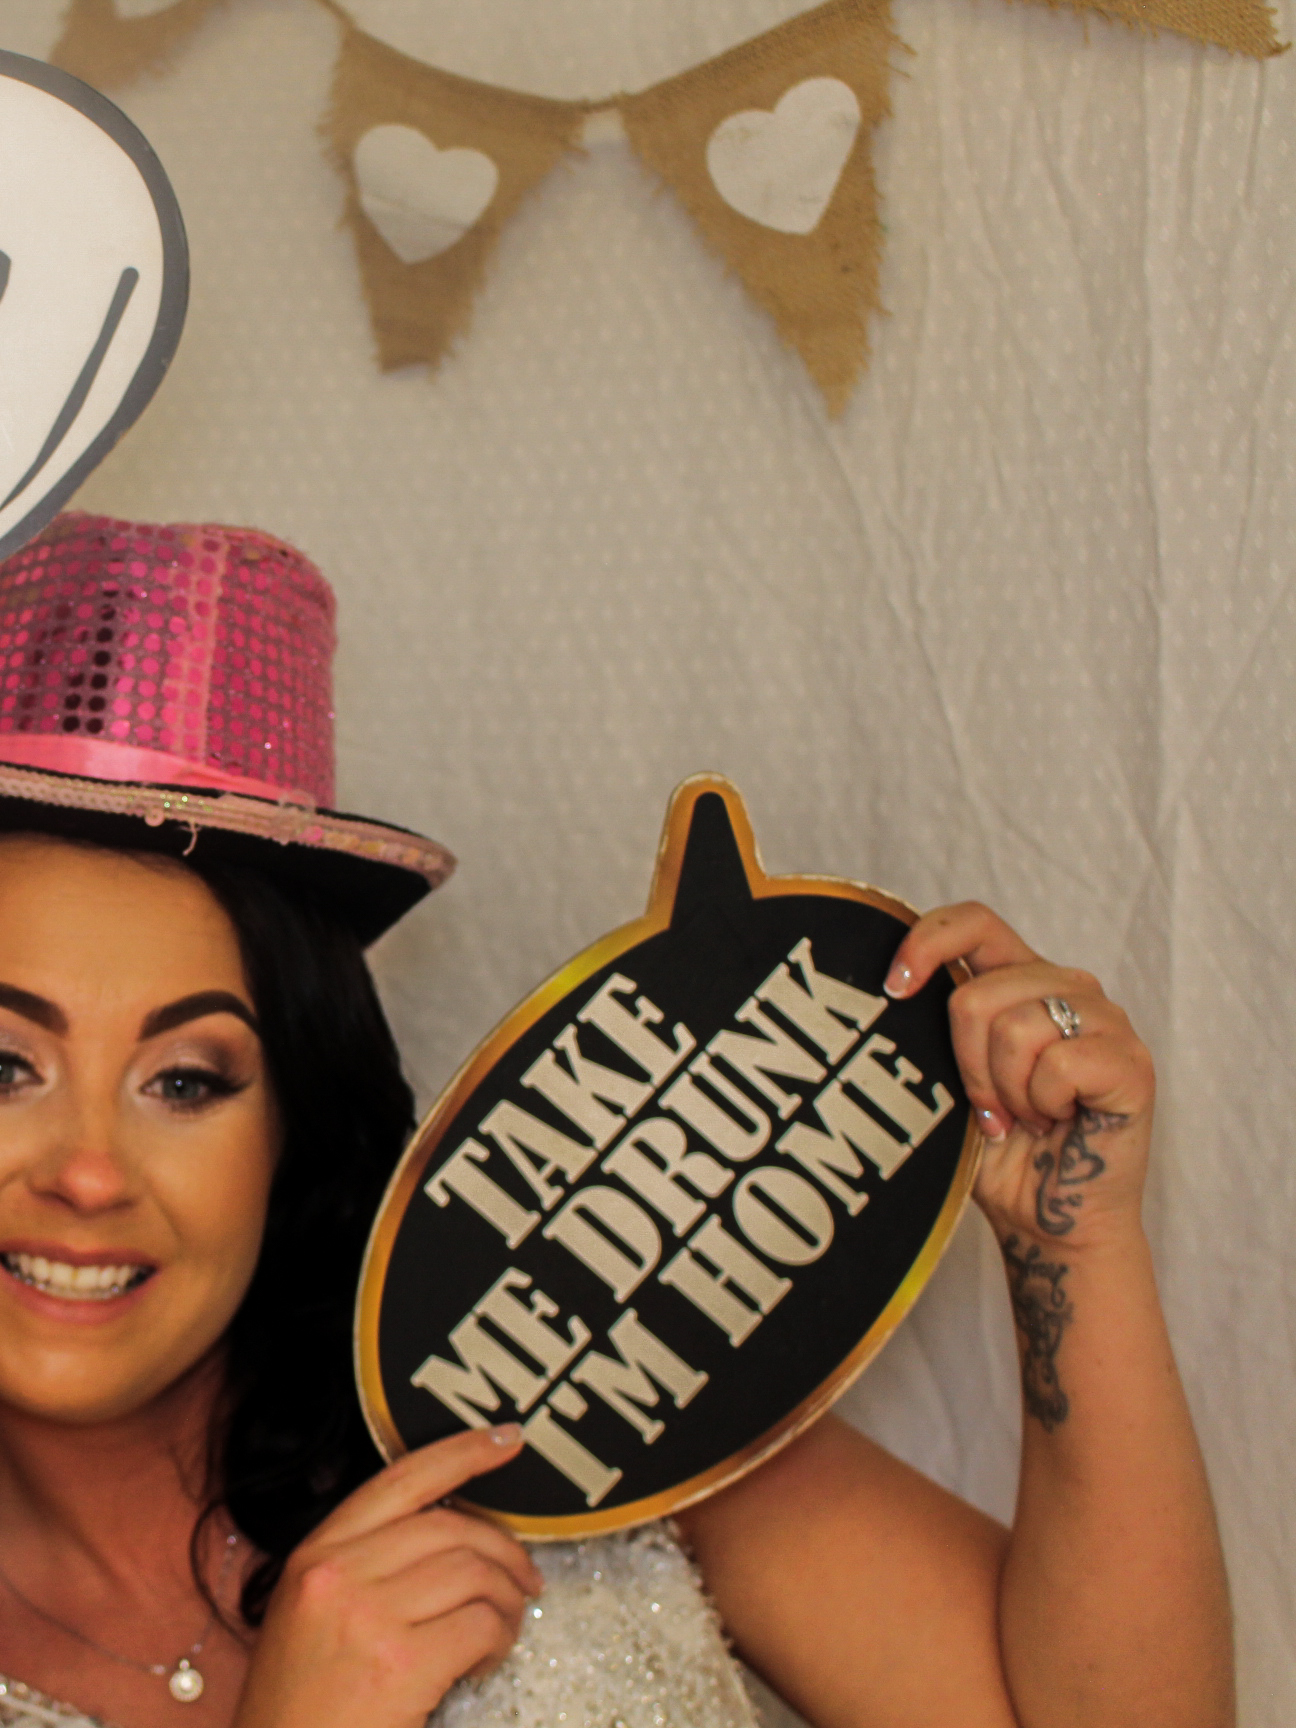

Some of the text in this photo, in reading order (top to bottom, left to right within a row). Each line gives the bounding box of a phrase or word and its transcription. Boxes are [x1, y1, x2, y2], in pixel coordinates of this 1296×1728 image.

[411, 937, 887, 1430] ME DRUNK
[425, 972, 696, 1249] TAKE
[520, 1034, 954, 1507] I'M HOME
